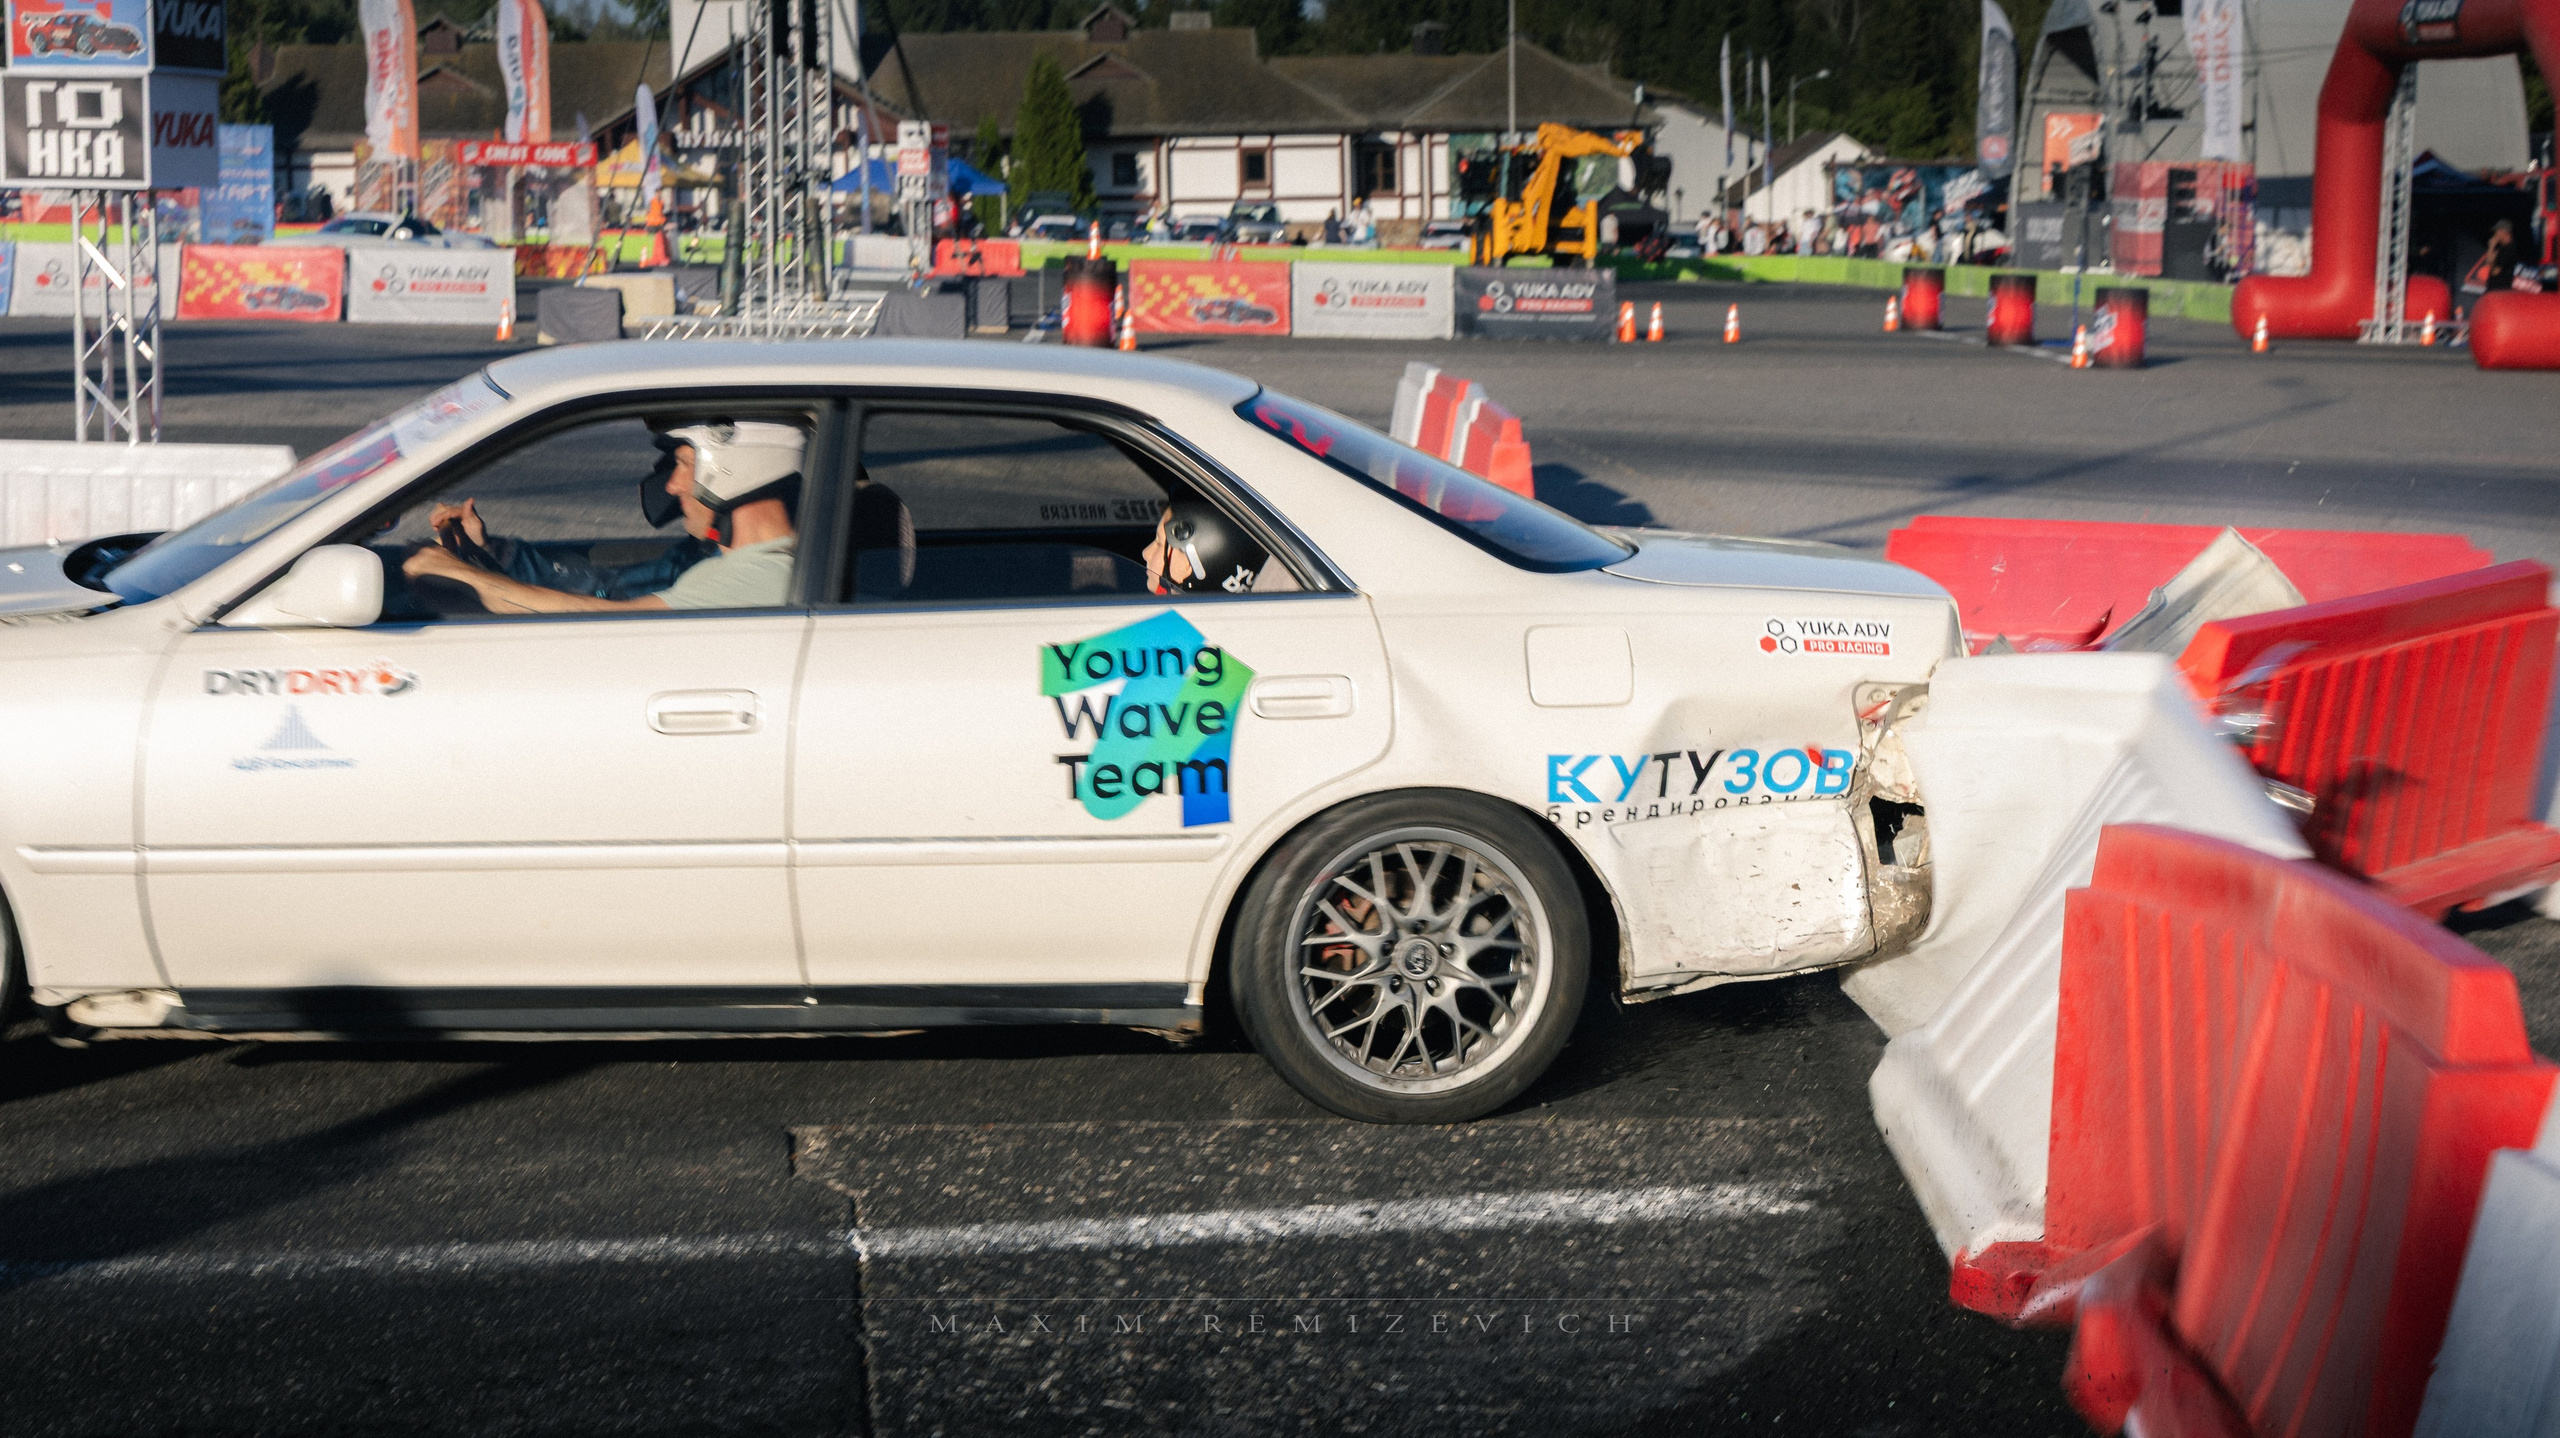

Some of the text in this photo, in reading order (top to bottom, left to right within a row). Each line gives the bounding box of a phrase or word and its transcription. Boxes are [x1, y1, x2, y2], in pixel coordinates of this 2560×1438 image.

[157, 2, 222, 40] YUKA
[154, 111, 214, 148] YUKA
[1512, 282, 1596, 298] YUKA ADV
[1796, 620, 1890, 638] YUKA ADV
[1809, 640, 1884, 654] PRO RACING
[1048, 643, 1224, 686] Young
[1055, 694, 1226, 739] Wave
[1055, 754, 1229, 800] Team
[1548, 749, 1854, 802] КУТУЗОВ
